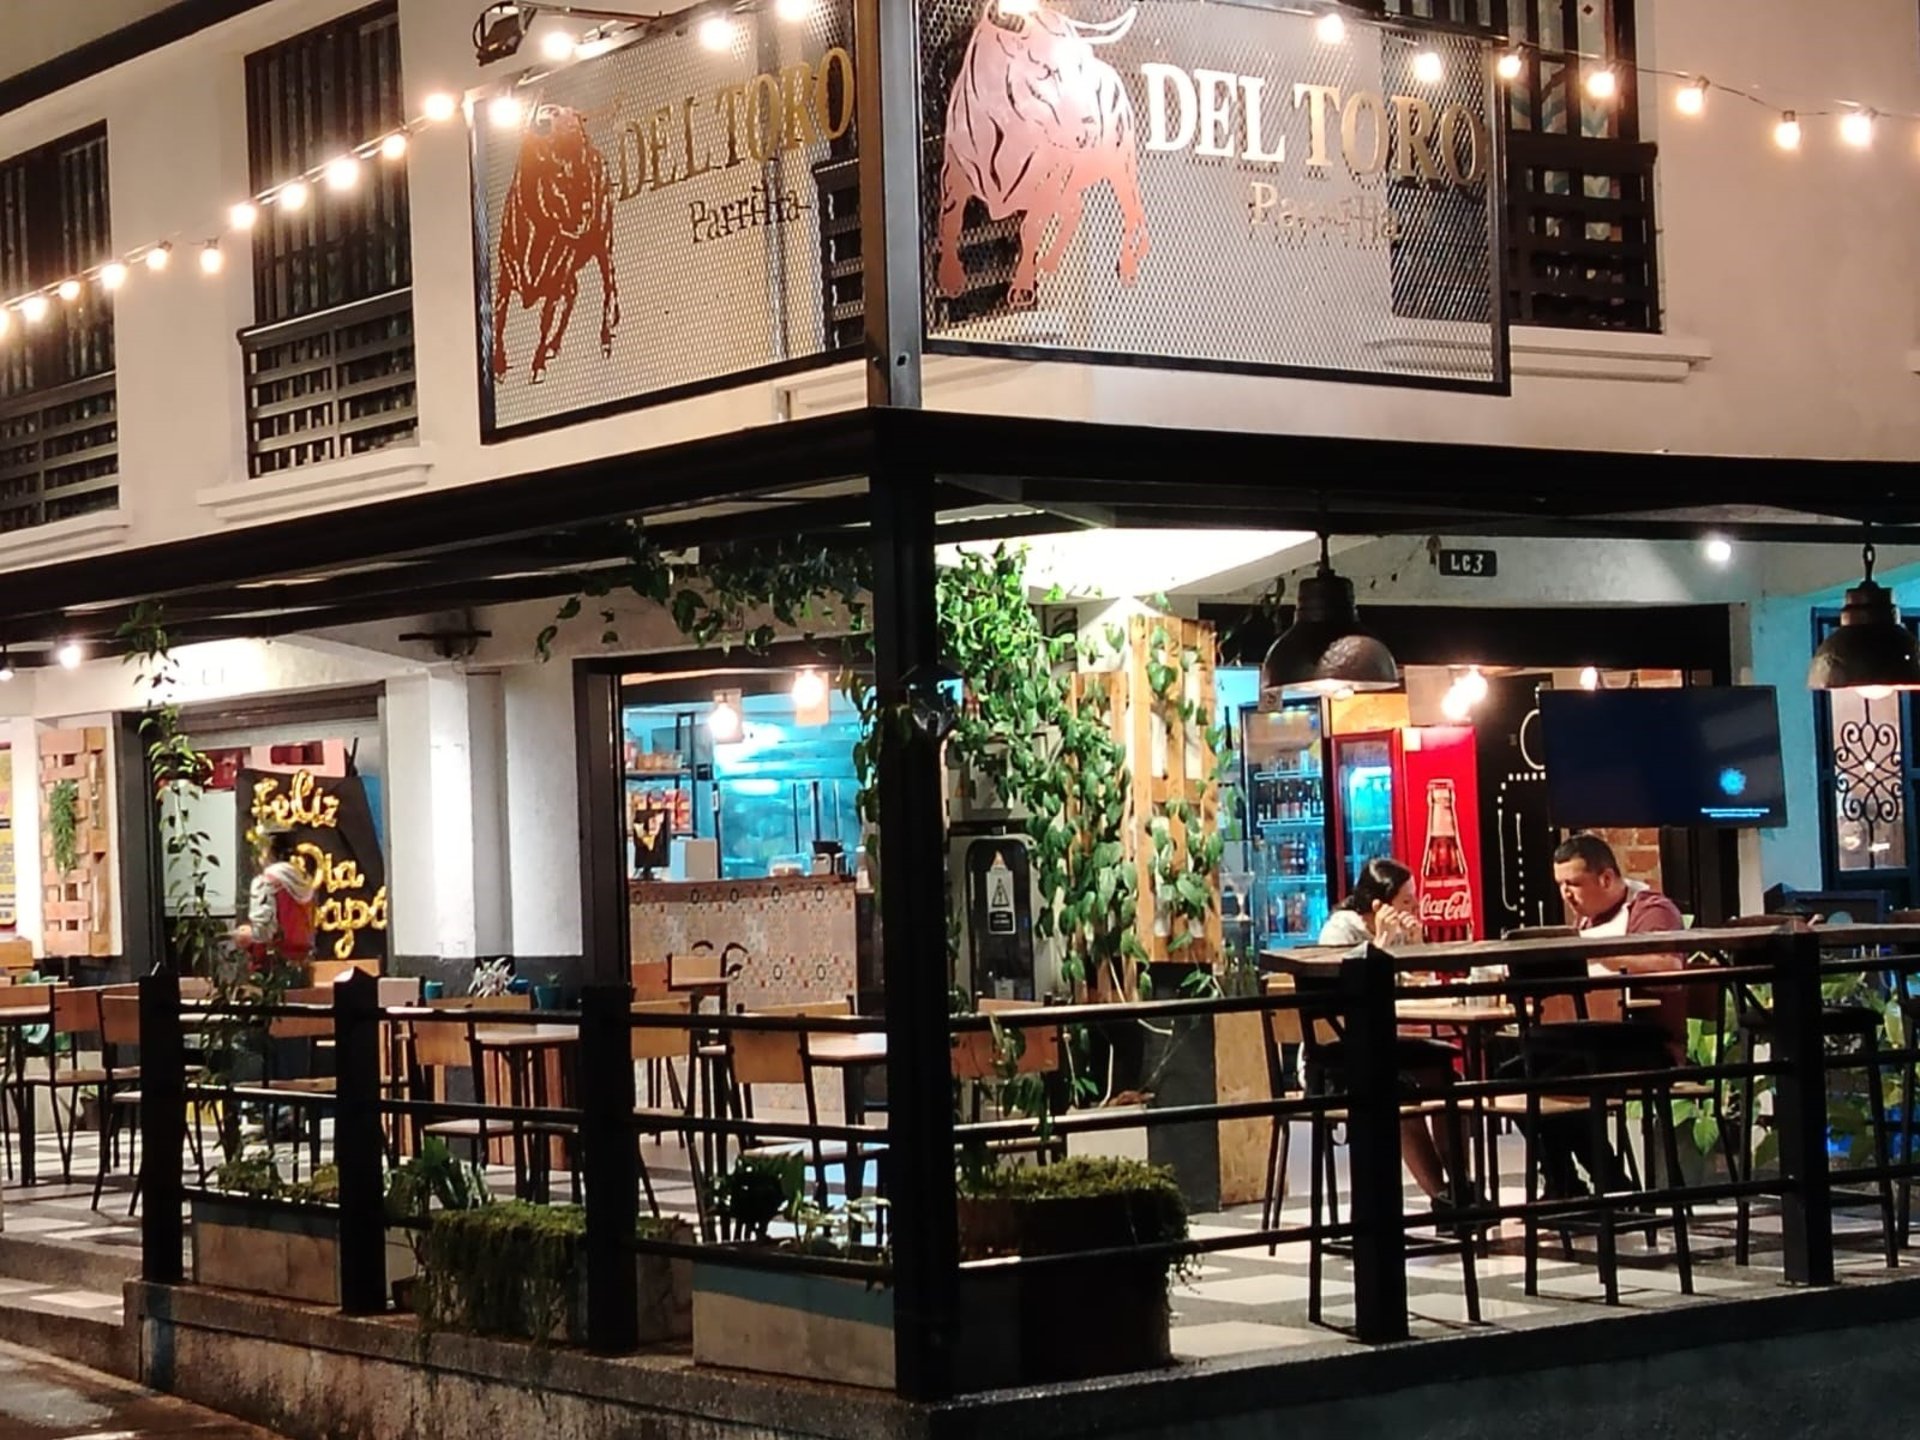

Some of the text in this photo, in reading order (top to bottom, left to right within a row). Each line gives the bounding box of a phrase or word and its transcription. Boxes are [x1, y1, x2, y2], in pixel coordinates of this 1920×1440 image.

[617, 47, 855, 202] DEL TORO
[1141, 62, 1486, 187] DEL TORO
[689, 180, 801, 244] Parrilla
[1451, 553, 1484, 574] LC3
[251, 769, 340, 829] Feliz
